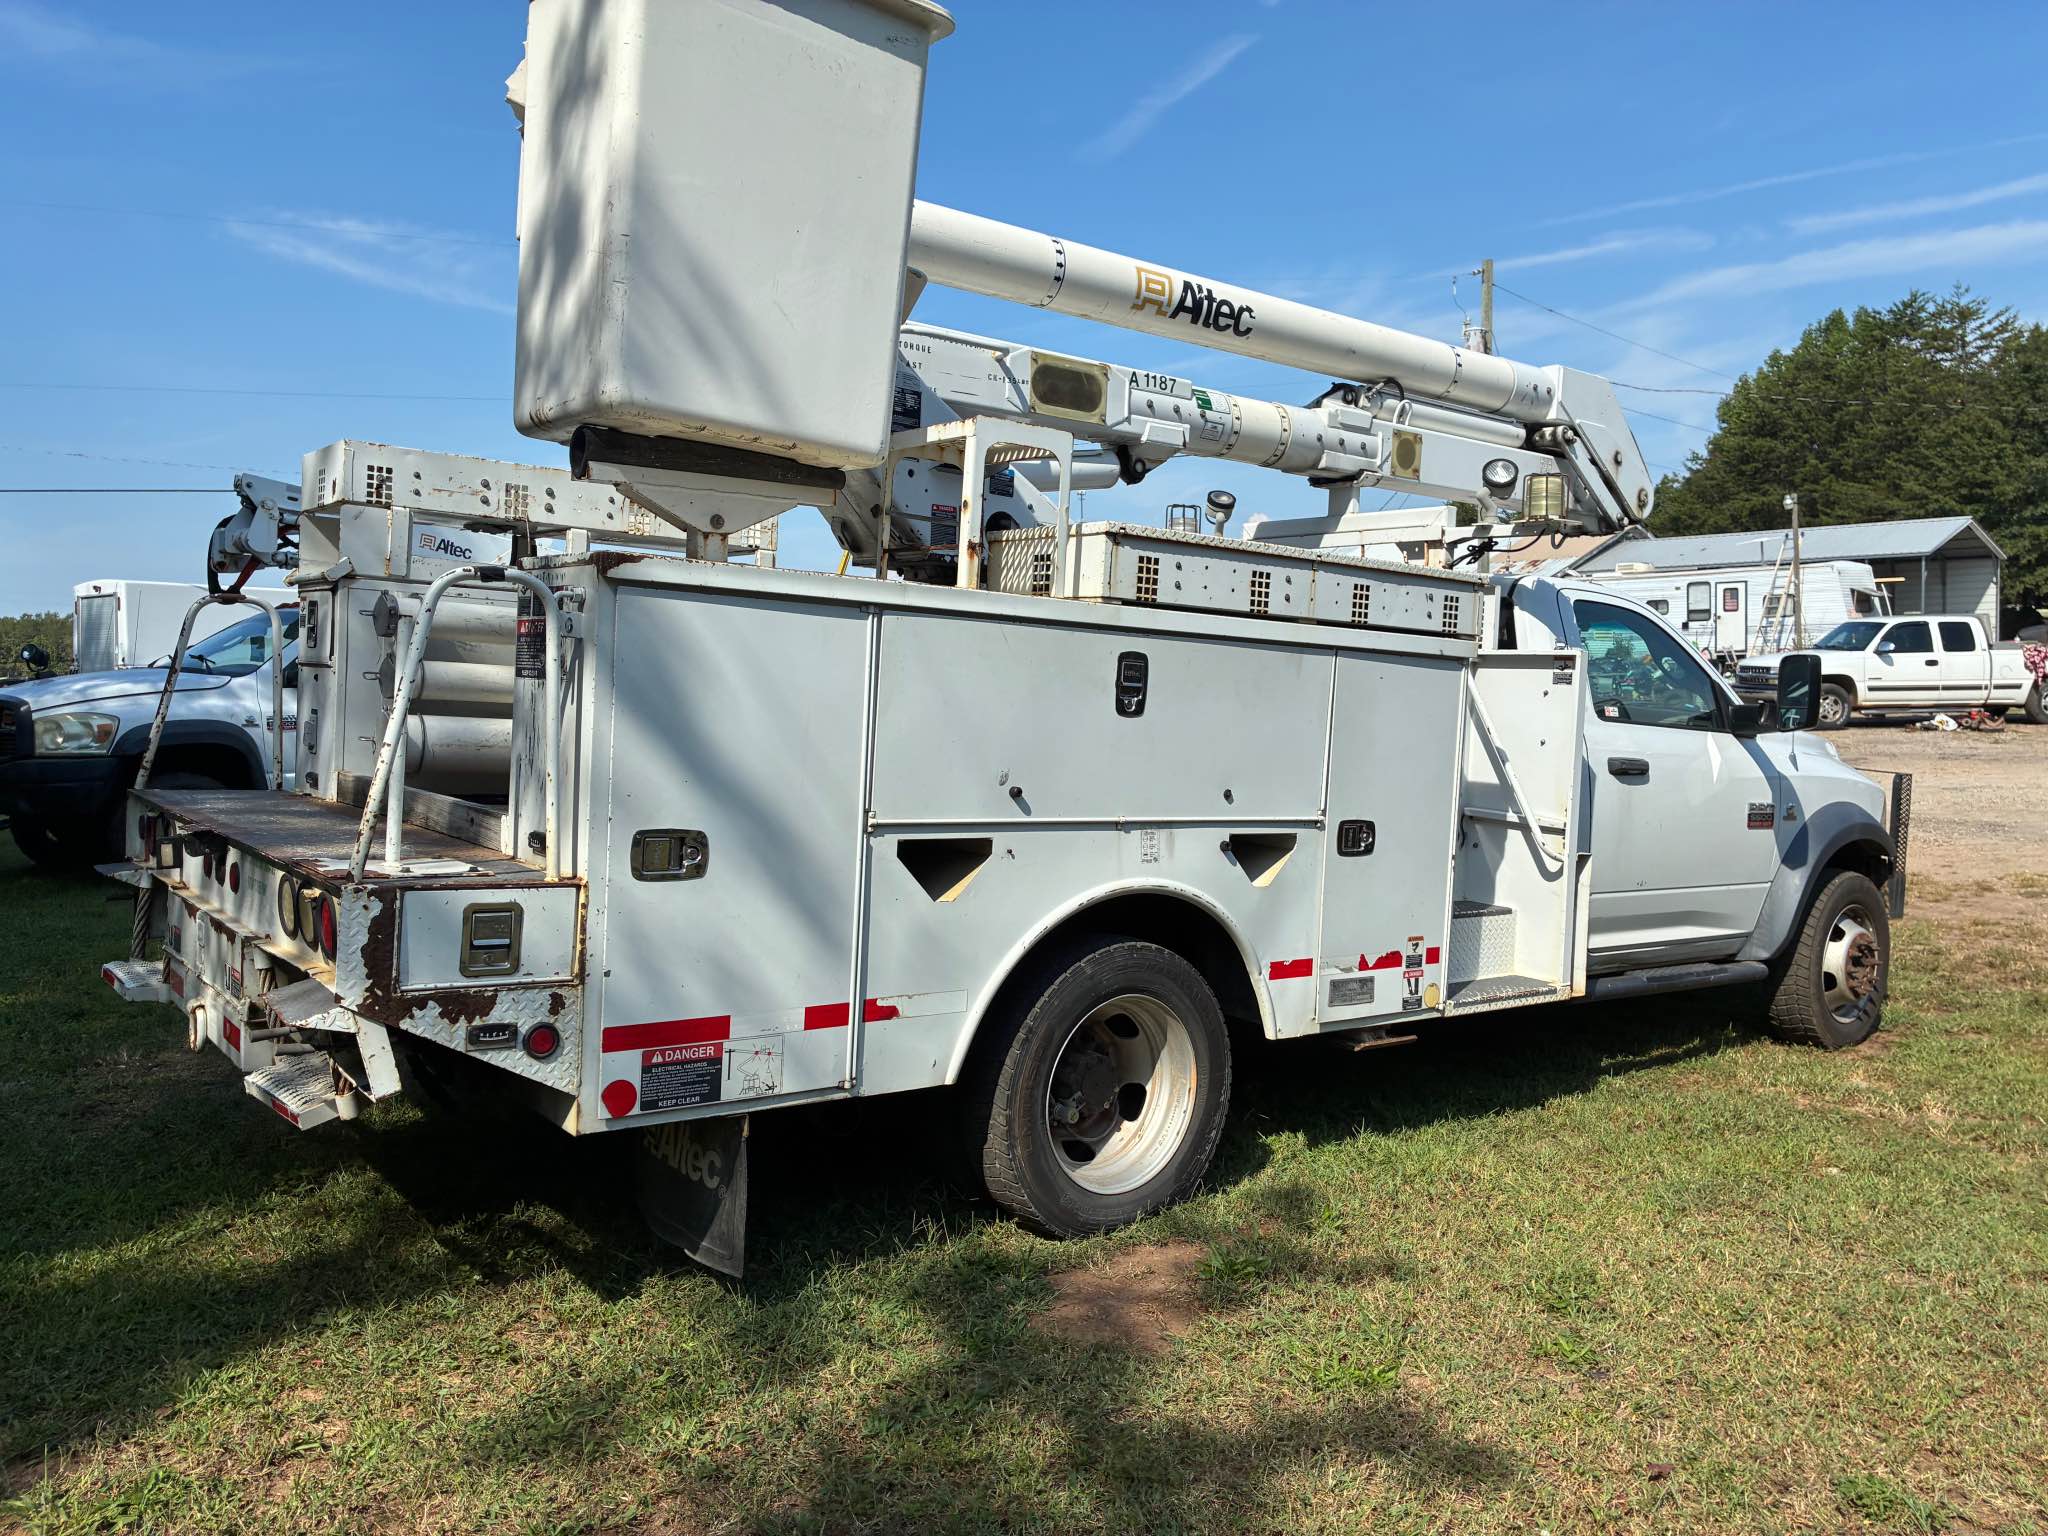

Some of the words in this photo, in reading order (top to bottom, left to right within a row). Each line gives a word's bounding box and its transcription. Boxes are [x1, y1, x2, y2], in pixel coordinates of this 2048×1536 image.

[1129, 370, 1140, 388] A
[1143, 372, 1177, 394] 1187
[435, 538, 473, 560] Altec
[665, 1046, 715, 1062] DANGER
[658, 1098, 677, 1108] KEEP
[677, 1095, 700, 1106] CLEAR
